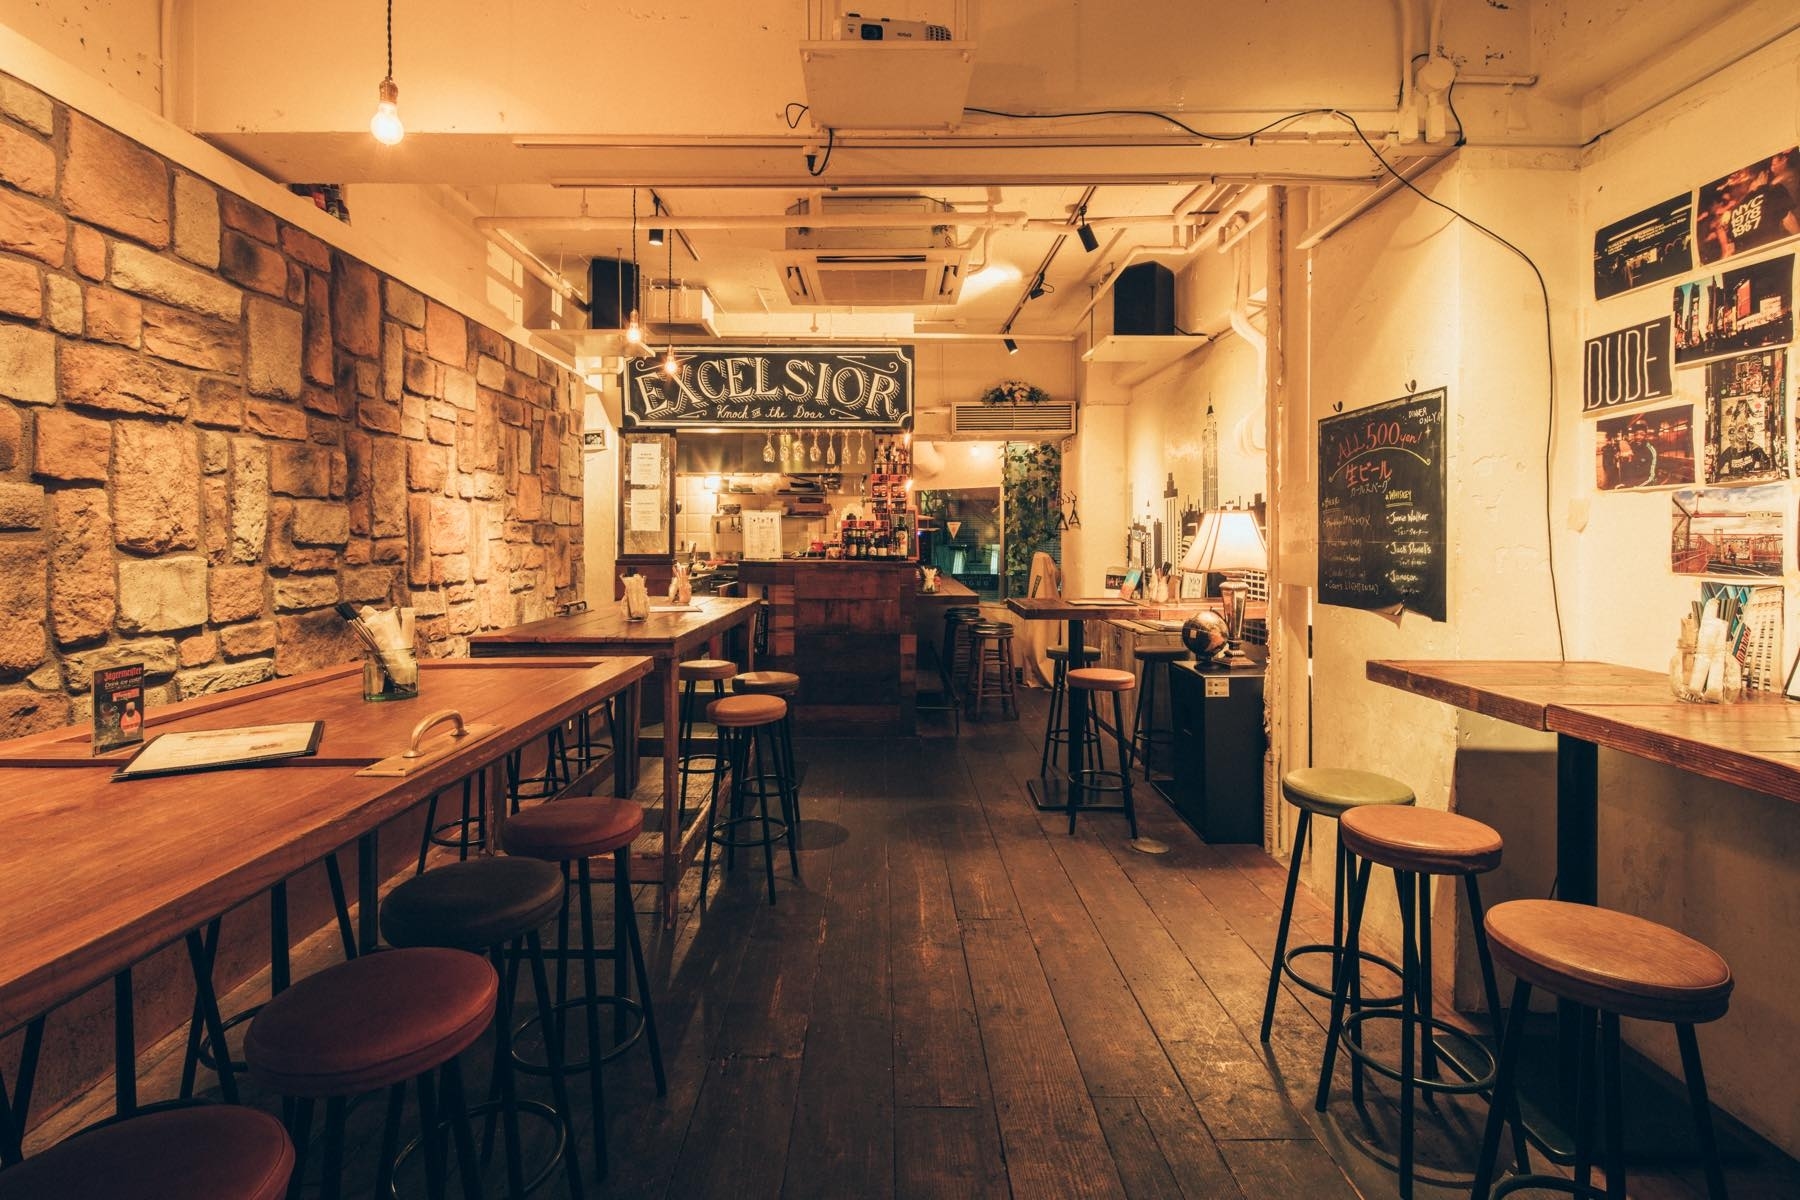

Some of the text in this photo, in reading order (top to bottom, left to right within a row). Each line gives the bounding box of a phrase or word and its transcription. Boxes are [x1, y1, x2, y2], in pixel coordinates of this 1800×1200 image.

[1731, 194, 1764, 219] NYC
[1586, 322, 1661, 410] DUDE
[636, 357, 899, 419] EXCELSIOR
[716, 405, 749, 419] Knock
[765, 406, 787, 418] the
[1345, 459, 1392, 488] 生ビール
